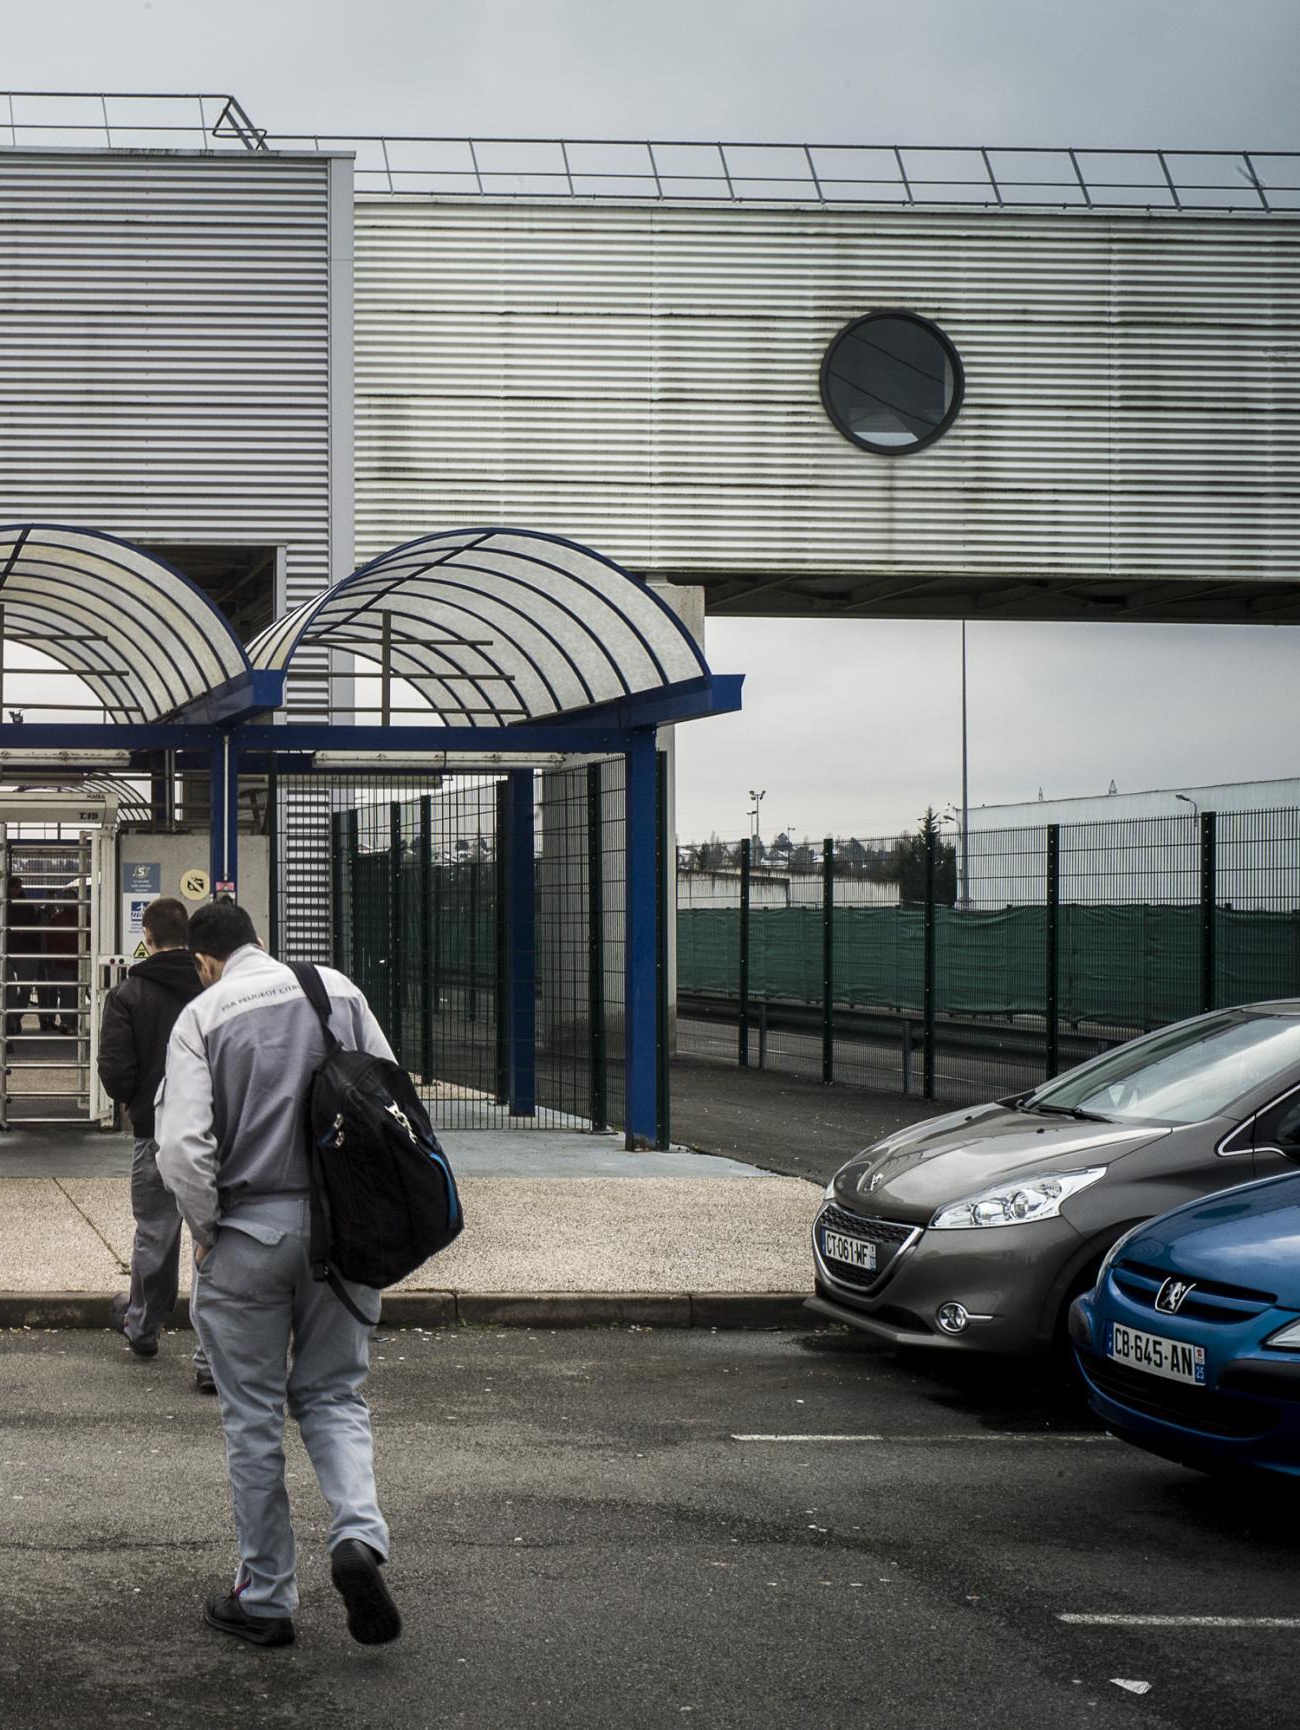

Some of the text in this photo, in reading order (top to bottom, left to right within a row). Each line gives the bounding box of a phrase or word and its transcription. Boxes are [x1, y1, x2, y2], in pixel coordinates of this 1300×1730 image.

[221, 1001, 237, 1012] PSA
[238, 988, 277, 1004] PEUGEOT
[826, 1232, 869, 1265] CT-061-WF
[1114, 1327, 1193, 1377] CB-645-AN
[1195, 1365, 1205, 1380] 25
